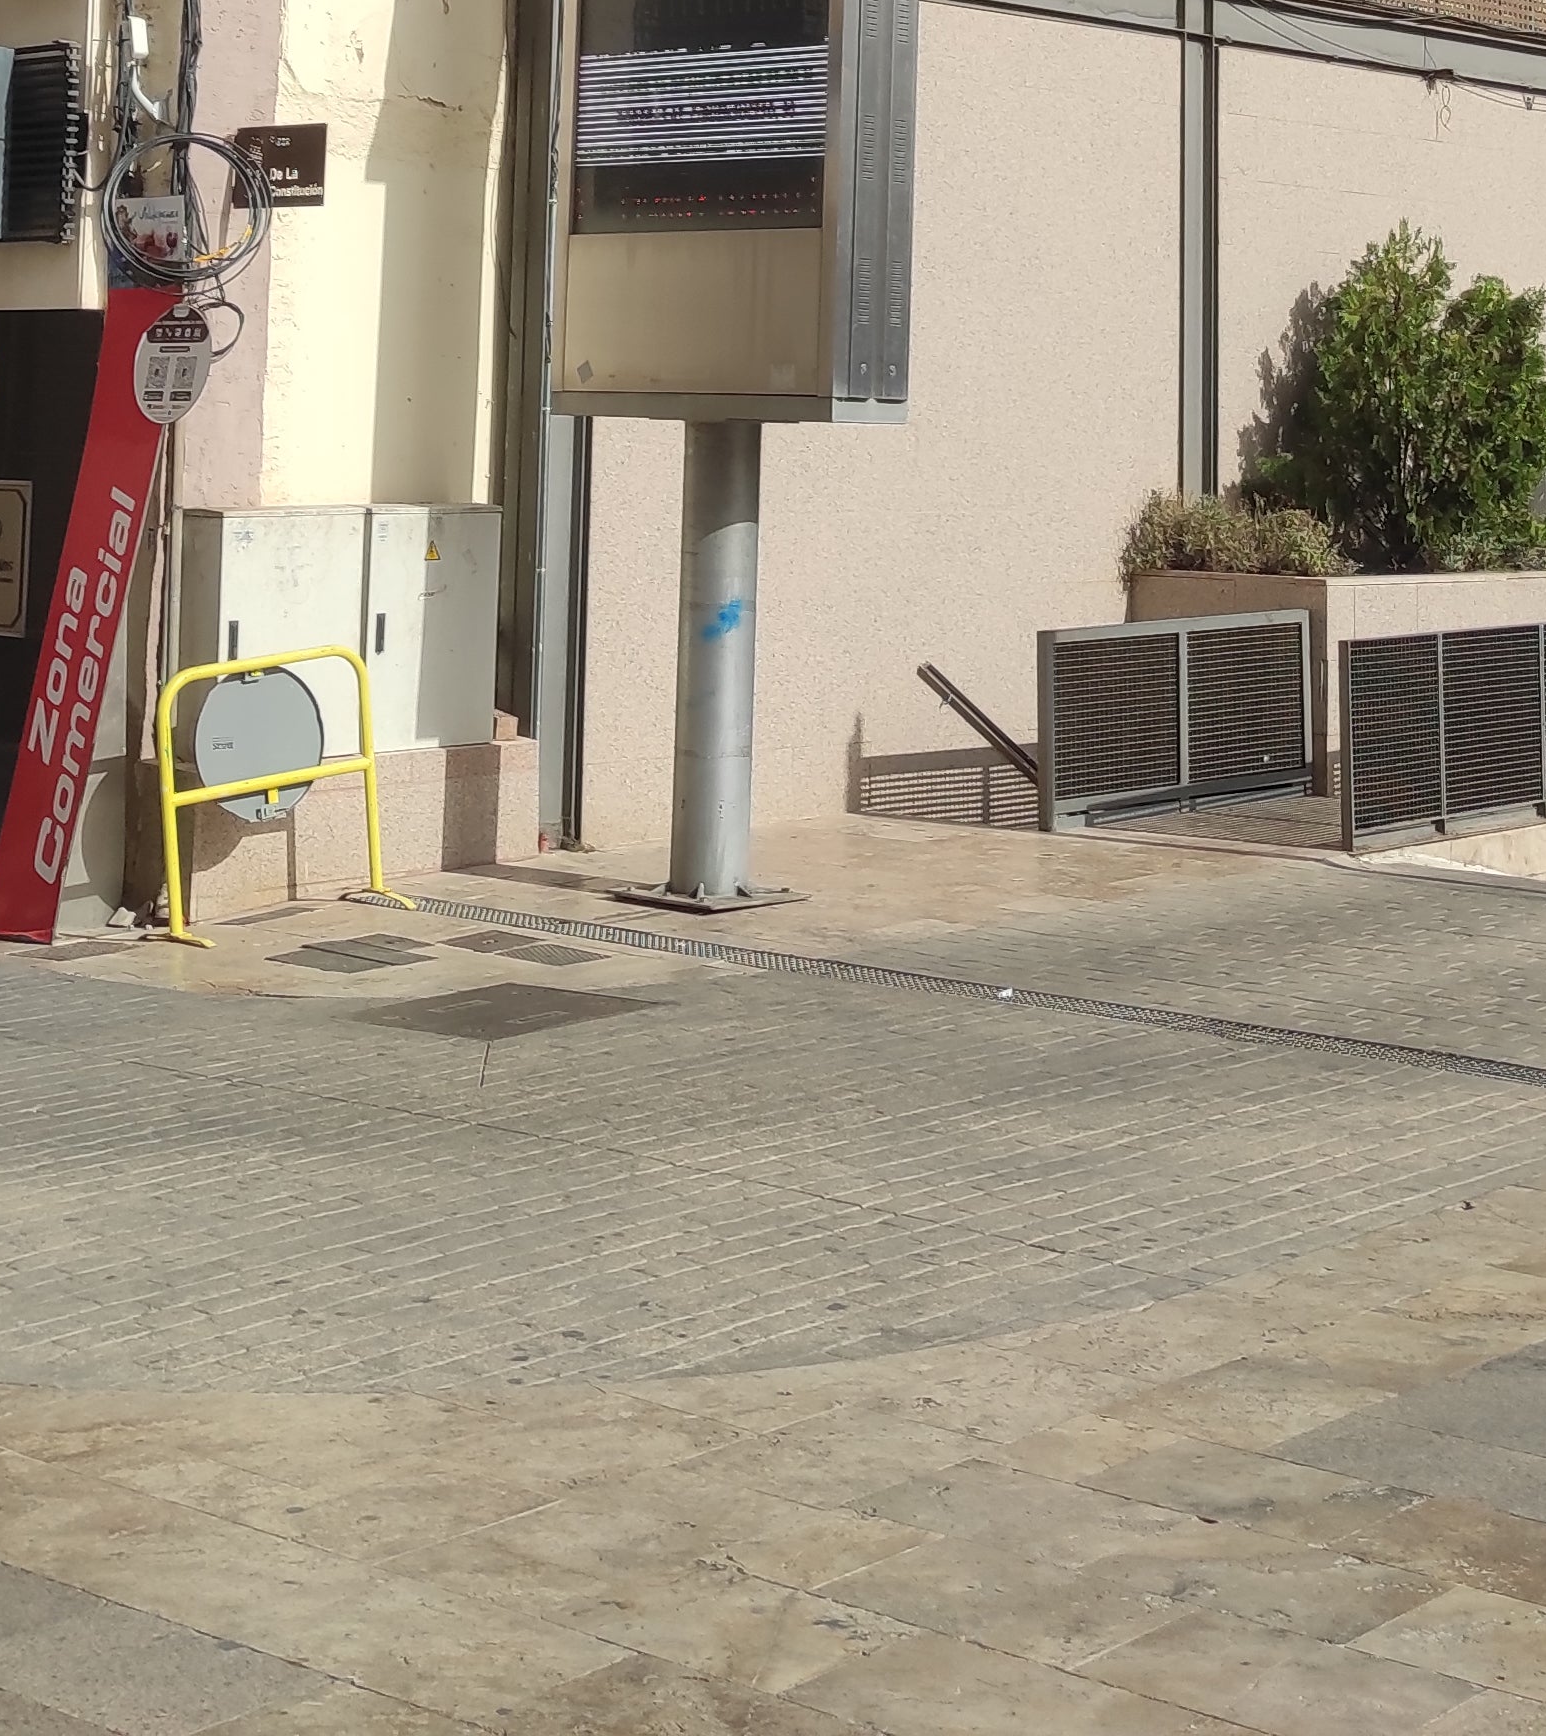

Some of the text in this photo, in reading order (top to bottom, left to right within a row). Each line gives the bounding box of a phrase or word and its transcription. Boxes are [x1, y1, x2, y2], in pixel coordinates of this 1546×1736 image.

[269, 166, 299, 181] De La
[269, 183, 324, 198] Constitución
[27, 565, 89, 766] Zona
[34, 486, 136, 885] Comercial
